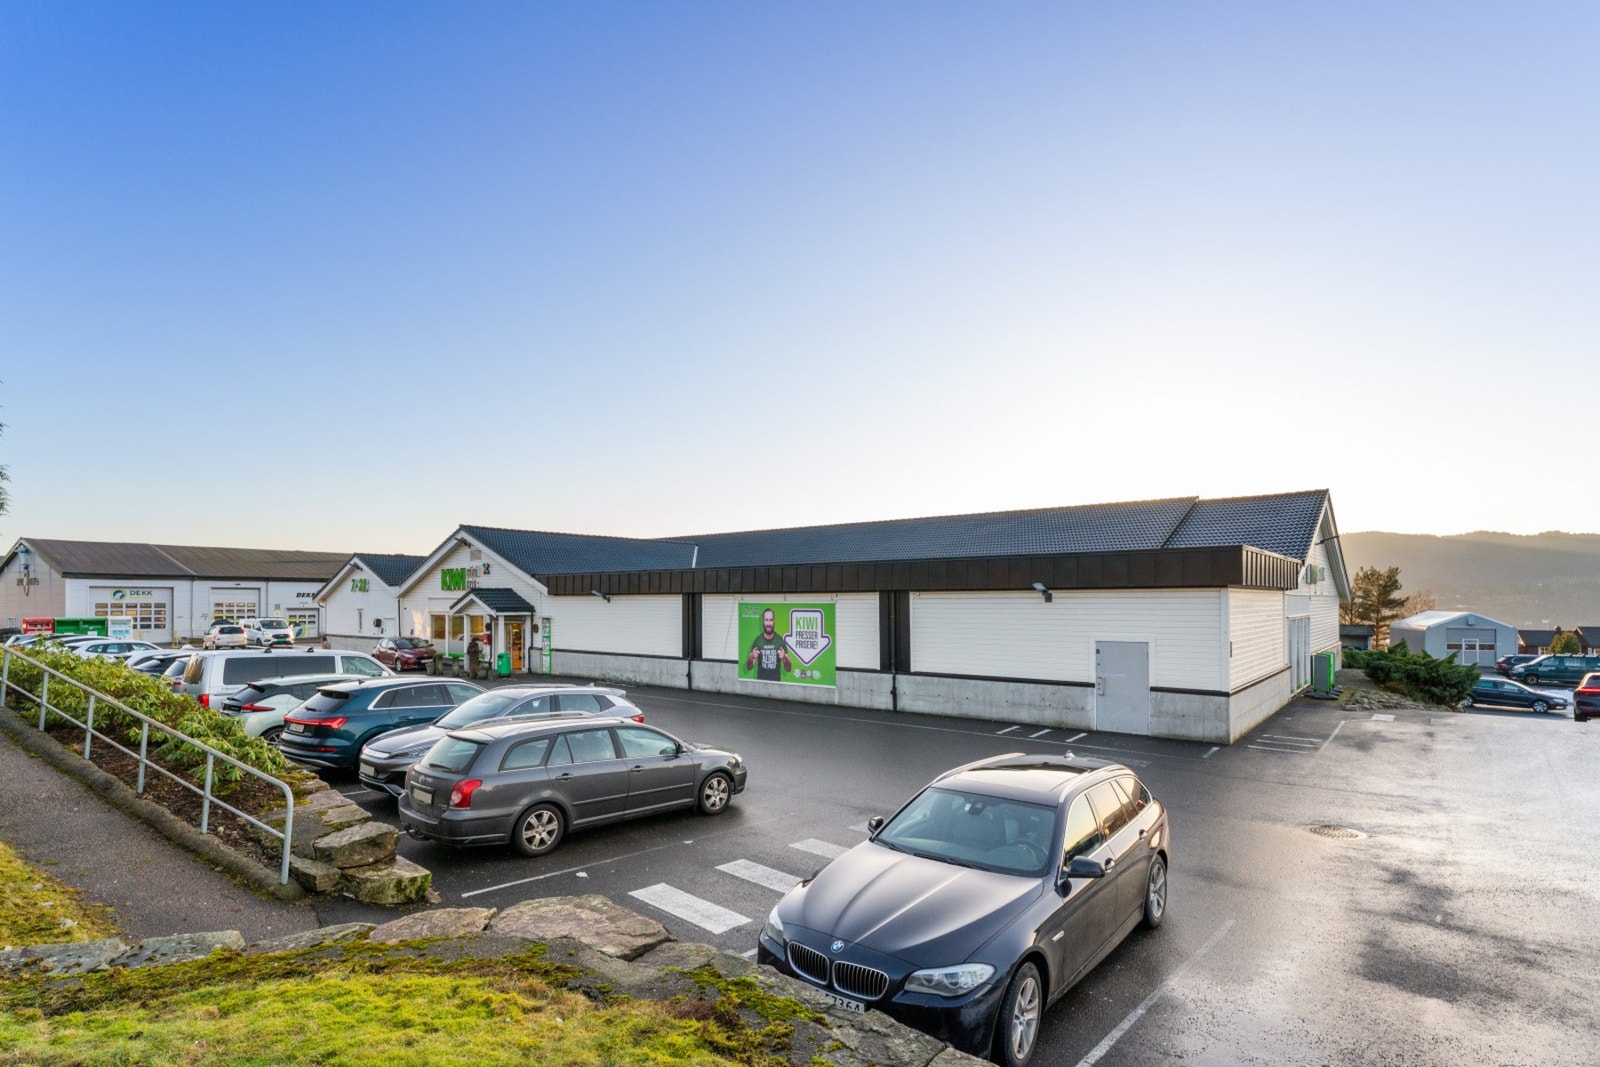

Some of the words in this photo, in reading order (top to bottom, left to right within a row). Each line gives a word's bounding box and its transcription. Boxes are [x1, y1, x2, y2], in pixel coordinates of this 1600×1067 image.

[441, 568, 467, 591] KIWI
[795, 616, 818, 630] KIWI
[795, 630, 818, 640] PRESSER
